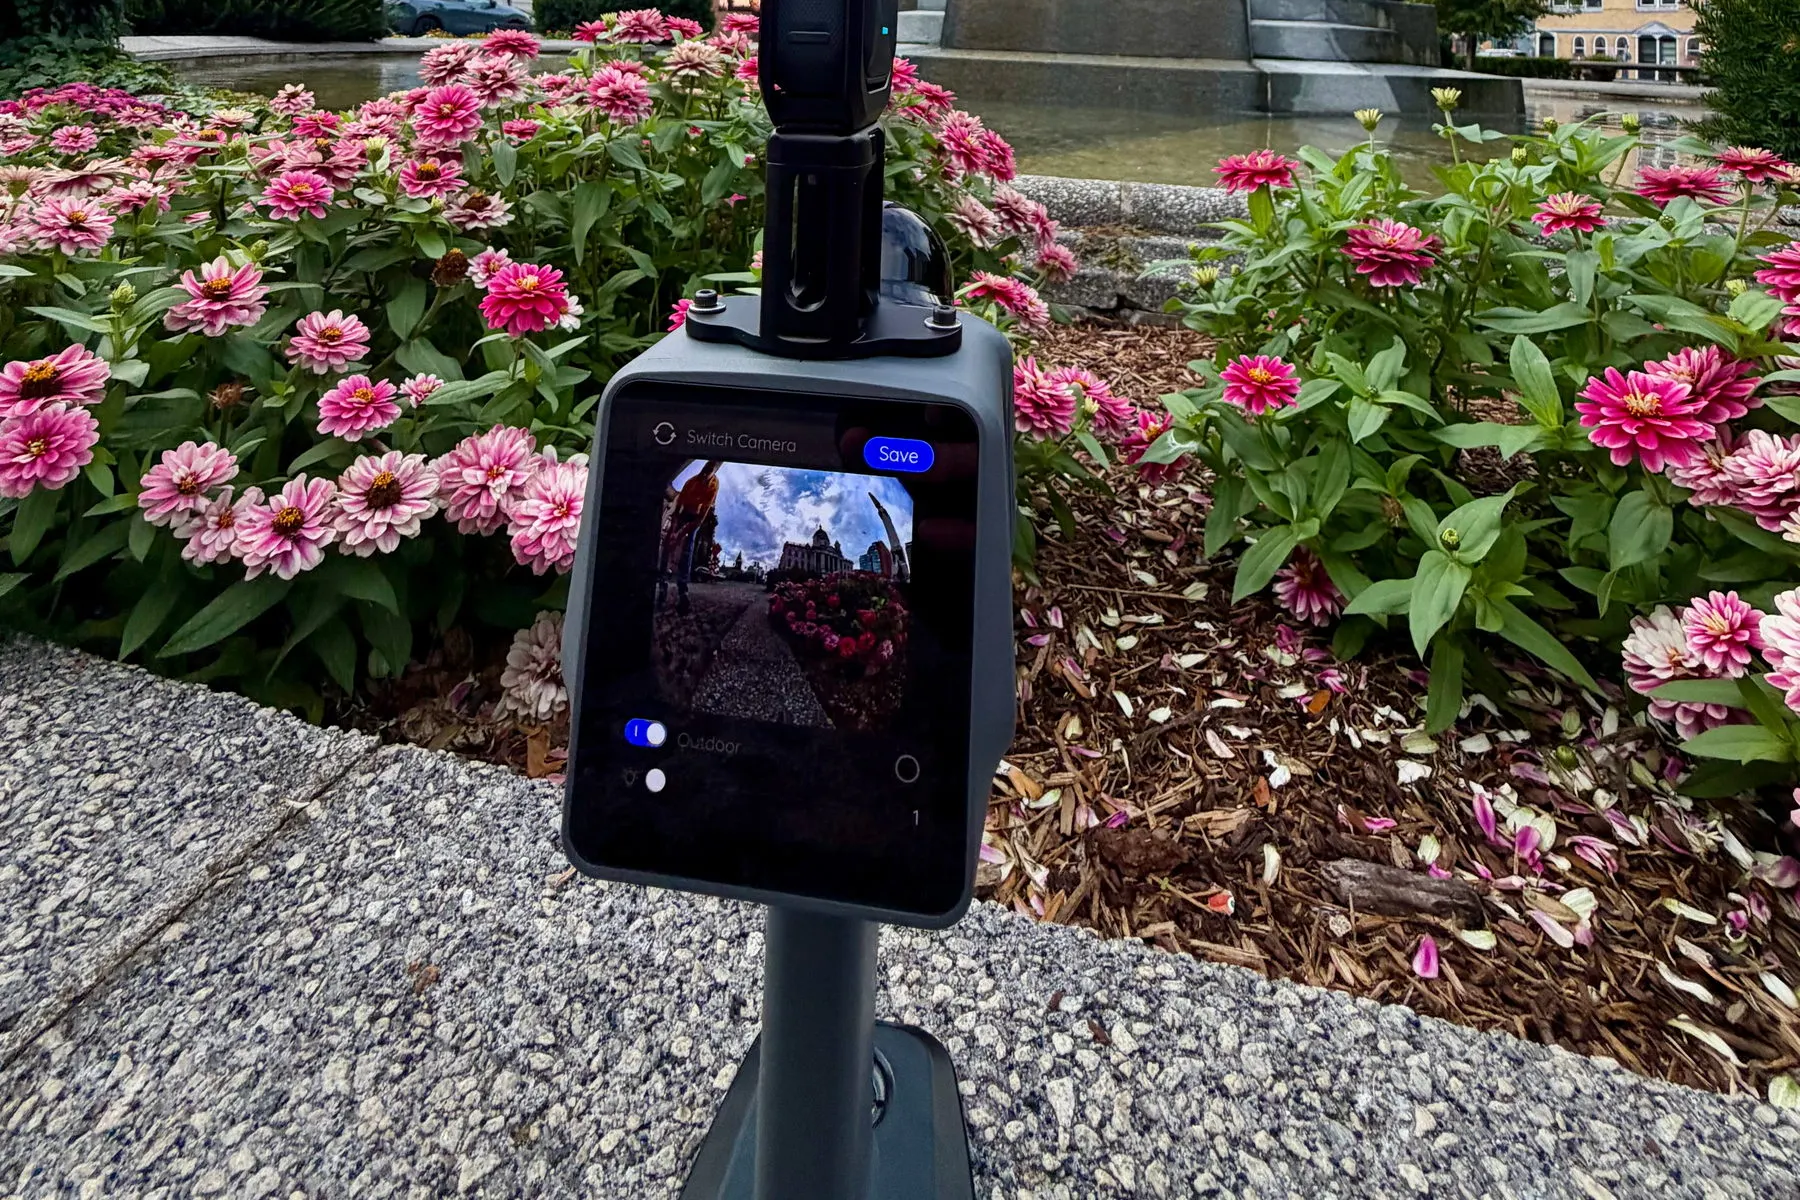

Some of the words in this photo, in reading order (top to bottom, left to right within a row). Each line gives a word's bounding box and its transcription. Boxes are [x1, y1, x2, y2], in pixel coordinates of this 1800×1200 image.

[687, 429, 733, 448] Switch
[737, 432, 796, 453] Camera
[879, 446, 919, 464] Save
[677, 732, 742, 754] Outdoor
[912, 809, 919, 826] 1
